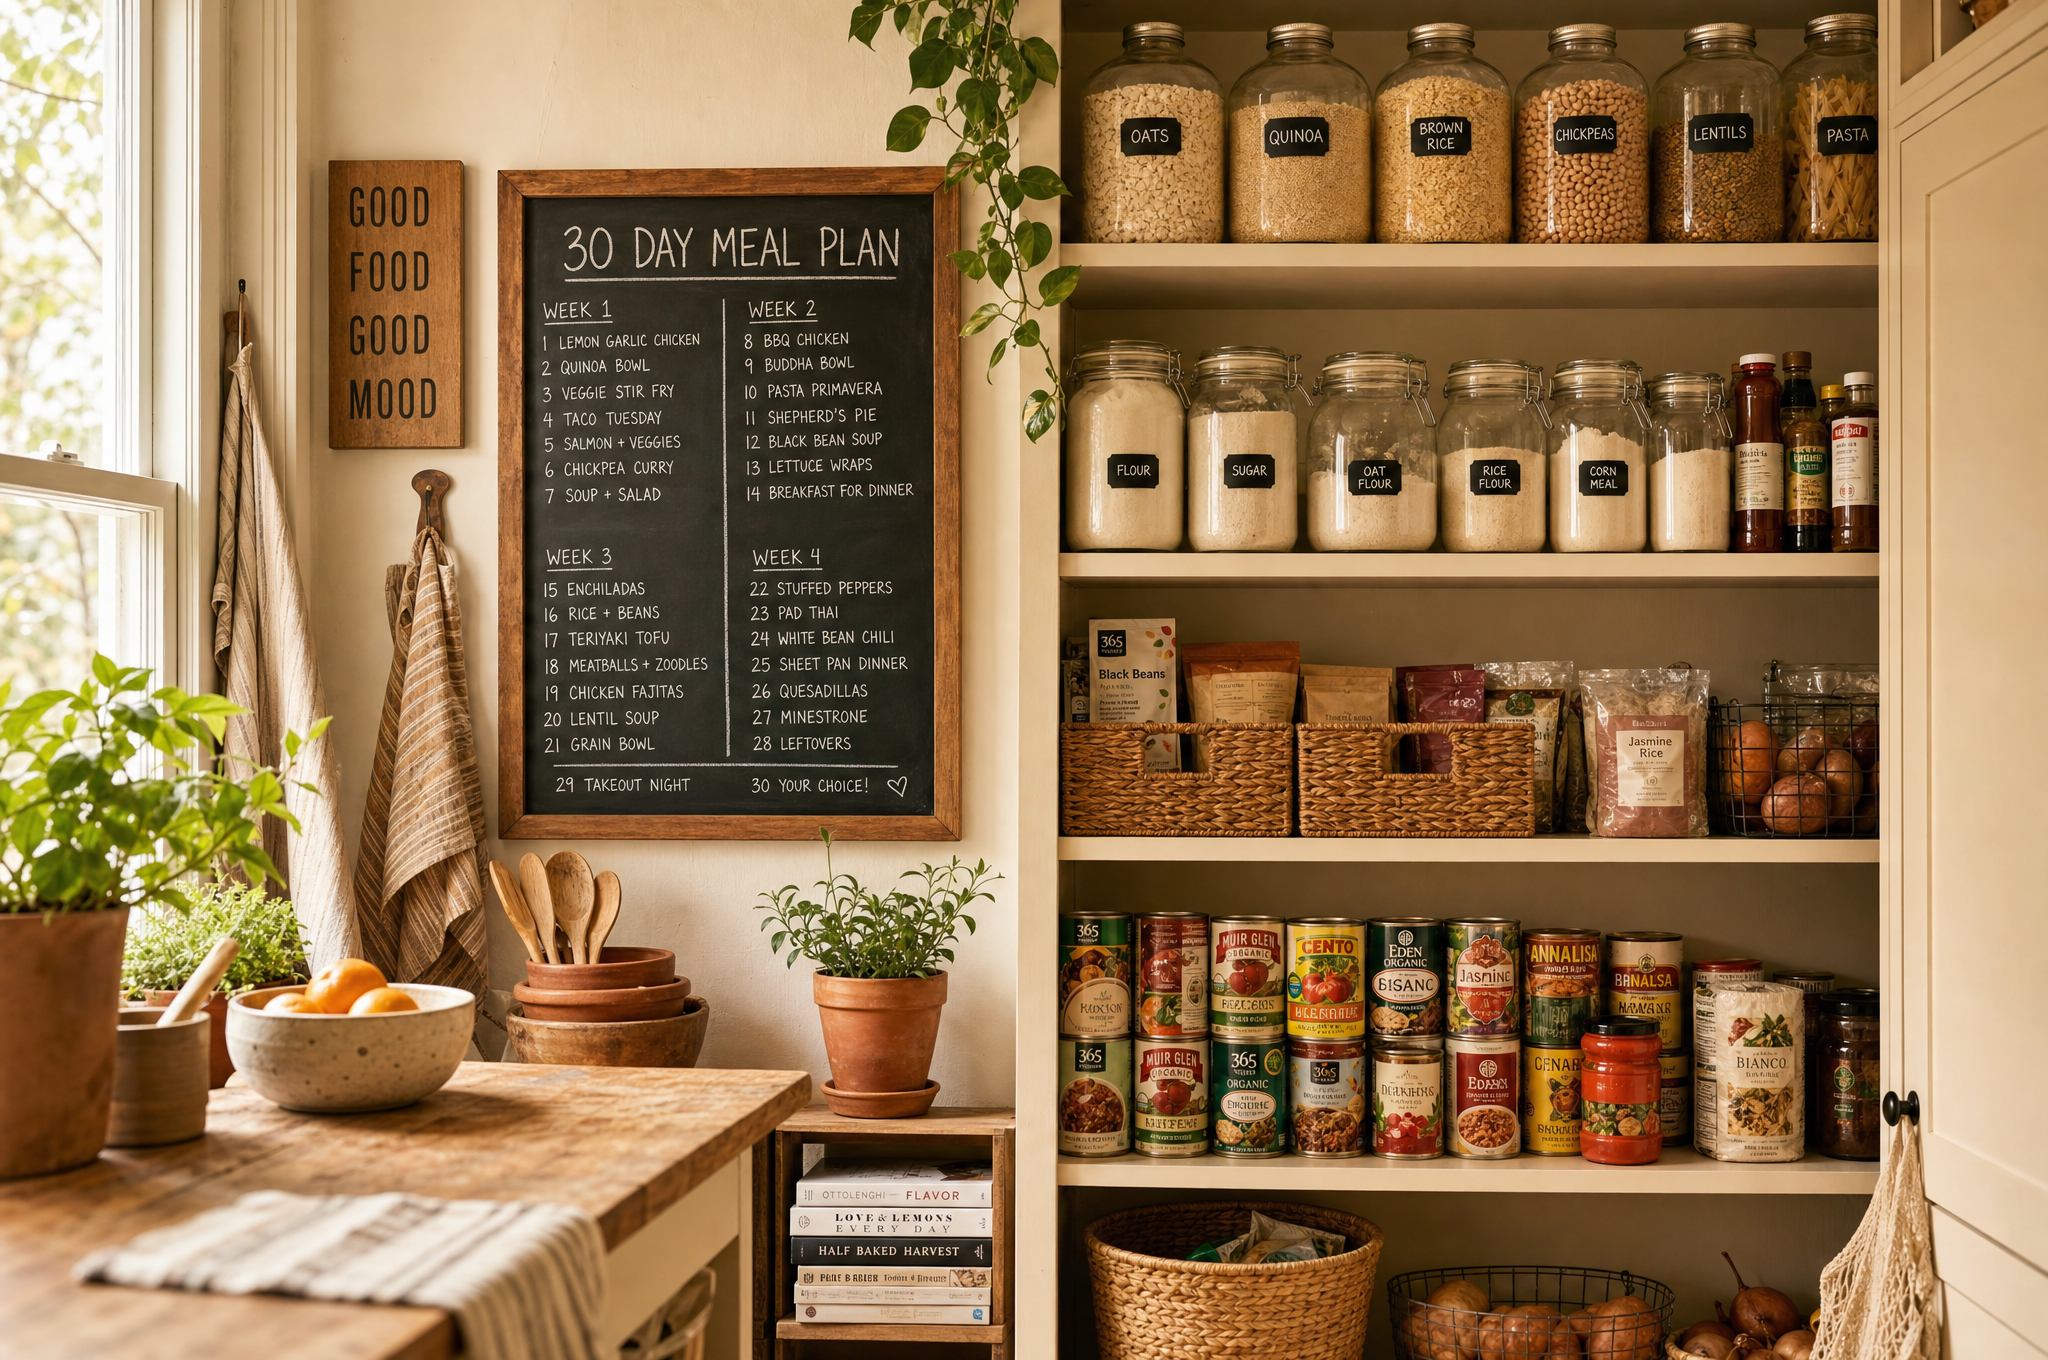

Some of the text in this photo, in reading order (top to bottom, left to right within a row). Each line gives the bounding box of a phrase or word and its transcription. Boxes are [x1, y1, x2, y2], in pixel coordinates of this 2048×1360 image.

[1131, 129, 1168, 143] OATS
[1420, 122, 1462, 135] BROWN
[1556, 128, 1614, 141] CHICKPEAS
[1694, 126, 1746, 141] LENTILS
[1828, 128, 1869, 142] PASTA
[1269, 129, 1323, 145] QUINOA
[1428, 138, 1454, 150] RICE
[349, 187, 429, 227] GOOD
[564, 226, 899, 271] 30 DAY MEAL PLAN
[350, 251, 429, 291] FOOD
[543, 300, 611, 319] WEEK 1
[749, 300, 816, 318] WEEK 2
[349, 315, 429, 355] GOOD
[560, 333, 699, 349] LEMON GARLIC CHICKEN
[745, 332, 848, 349] 8 BBQ CHICKEN
[542, 359, 650, 376] 2 QUINOA BOWL
[765, 356, 854, 372] BUDDHA BOWL
[543, 384, 674, 402] 3 VEGGIE STIR FRY
[745, 382, 882, 399] 10 PASTA PRIMAVERA
[349, 379, 437, 419] MOOD
[543, 411, 661, 427] 4 TACO TUESDAY
[746, 408, 876, 425] 11 SHEPHERD'S PIE
[545, 435, 680, 452] 5 SALMON VEGGIES
[747, 432, 882, 449] 12 BLACK BEAN SOUP
[545, 461, 673, 477] 6 CHICKPEA CURRY
[747, 458, 872, 475] 13 LETTUCE WRAPS
[1118, 465, 1151, 476] FLOUR
[1232, 465, 1267, 476] SUGAR
[1364, 466, 1385, 476] OAT
[1484, 466, 1506, 476] RICE
[1590, 466, 1616, 476] CORN
[1359, 479, 1392, 489] FLOUR
[1479, 479, 1511, 488] FLOUR
[1591, 479, 1617, 489] MEAL
[545, 488, 661, 503] 7 SOUP SALAD
[748, 483, 914, 501] 14 BREAKFAST FOR DINNER
[547, 548, 611, 565] WEEK 3
[753, 548, 819, 565] WEEK 4
[545, 582, 645, 597] 15 ENCHILADAS
[750, 581, 892, 596] 22 STUFFED PEPPERS
[545, 606, 659, 622] 16 RICE BEANS
[751, 606, 838, 621] 23 PAD THAI
[545, 631, 669, 648] 17 TERIYAKI TOFU
[751, 631, 893, 646] 24 WHITE BEAN CHILI
[1102, 635, 1122, 647] 365
[546, 658, 708, 674] 18 MEATBALLS ZOODLES
[752, 657, 908, 672] 25 SHEET PAN DINNER
[1099, 669, 1165, 679] Black Beans
[546, 685, 683, 701] 19 CHICKEN FAJITAS
[752, 684, 867, 698] 26 QUESADILLAS
[544, 711, 659, 727] 20 LENTIL SOUP
[753, 710, 867, 725] 27 MINESTRONE
[545, 737, 655, 753] 21 GRAIN BOWL
[753, 736, 851, 751] 28 LEFTOVERS
[1629, 737, 1672, 746] Jasmine
[1640, 749, 1663, 757] Rice
[556, 777, 690, 792] 29 TAKEOUT NIGHT
[752, 777, 867, 793] 30 YOUR CHOICE!
[1077, 924, 1099, 937] 365
[1223, 933, 1275, 948] MUIR GLEN
[1302, 940, 1353, 954] CENTO
[1531, 945, 1597, 963] ANNALISA
[1384, 958, 1427, 967] ORGANIC
[1079, 1048, 1102, 1063] 365
[1147, 1052, 1197, 1066] MUIR GLEN
[1231, 1052, 1256, 1068] 365
[1737, 1057, 1786, 1069] BIANCO
[1227, 1079, 1268, 1089] ORGANIC
[822, 1191, 960, 1200] OTTOLENGHI FLAVOR
[835, 1214, 953, 1222] LOVE & LEMONS
[915, 1225, 951, 1233] DAY
[819, 1246, 960, 1256] HALF BAKED HARVEST
